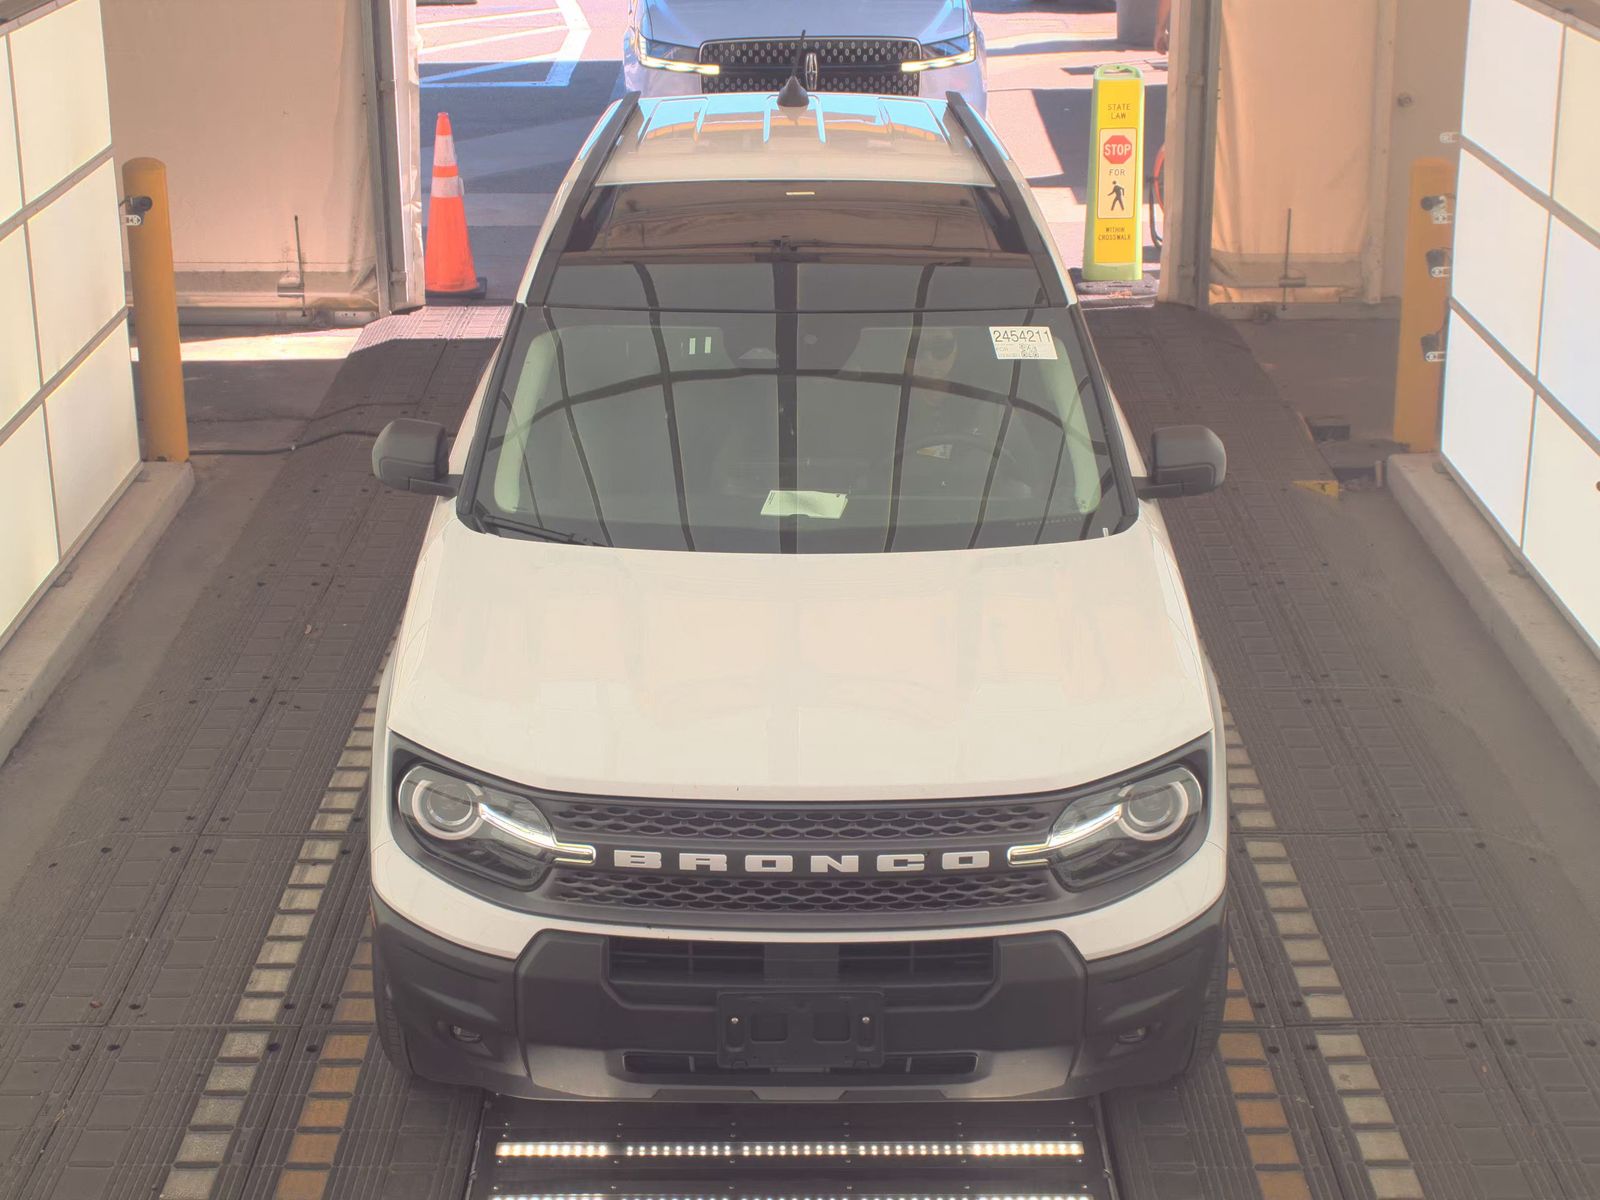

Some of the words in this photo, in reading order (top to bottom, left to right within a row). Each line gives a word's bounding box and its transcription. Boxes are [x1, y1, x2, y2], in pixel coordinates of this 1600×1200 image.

[1107, 103, 1131, 111] STATE
[1110, 112, 1127, 120] LAW
[1104, 143, 1131, 156] STOP
[1108, 168, 1126, 176] FOR
[993, 330, 1051, 342] 2454211
[613, 849, 990, 873] BRONCO
